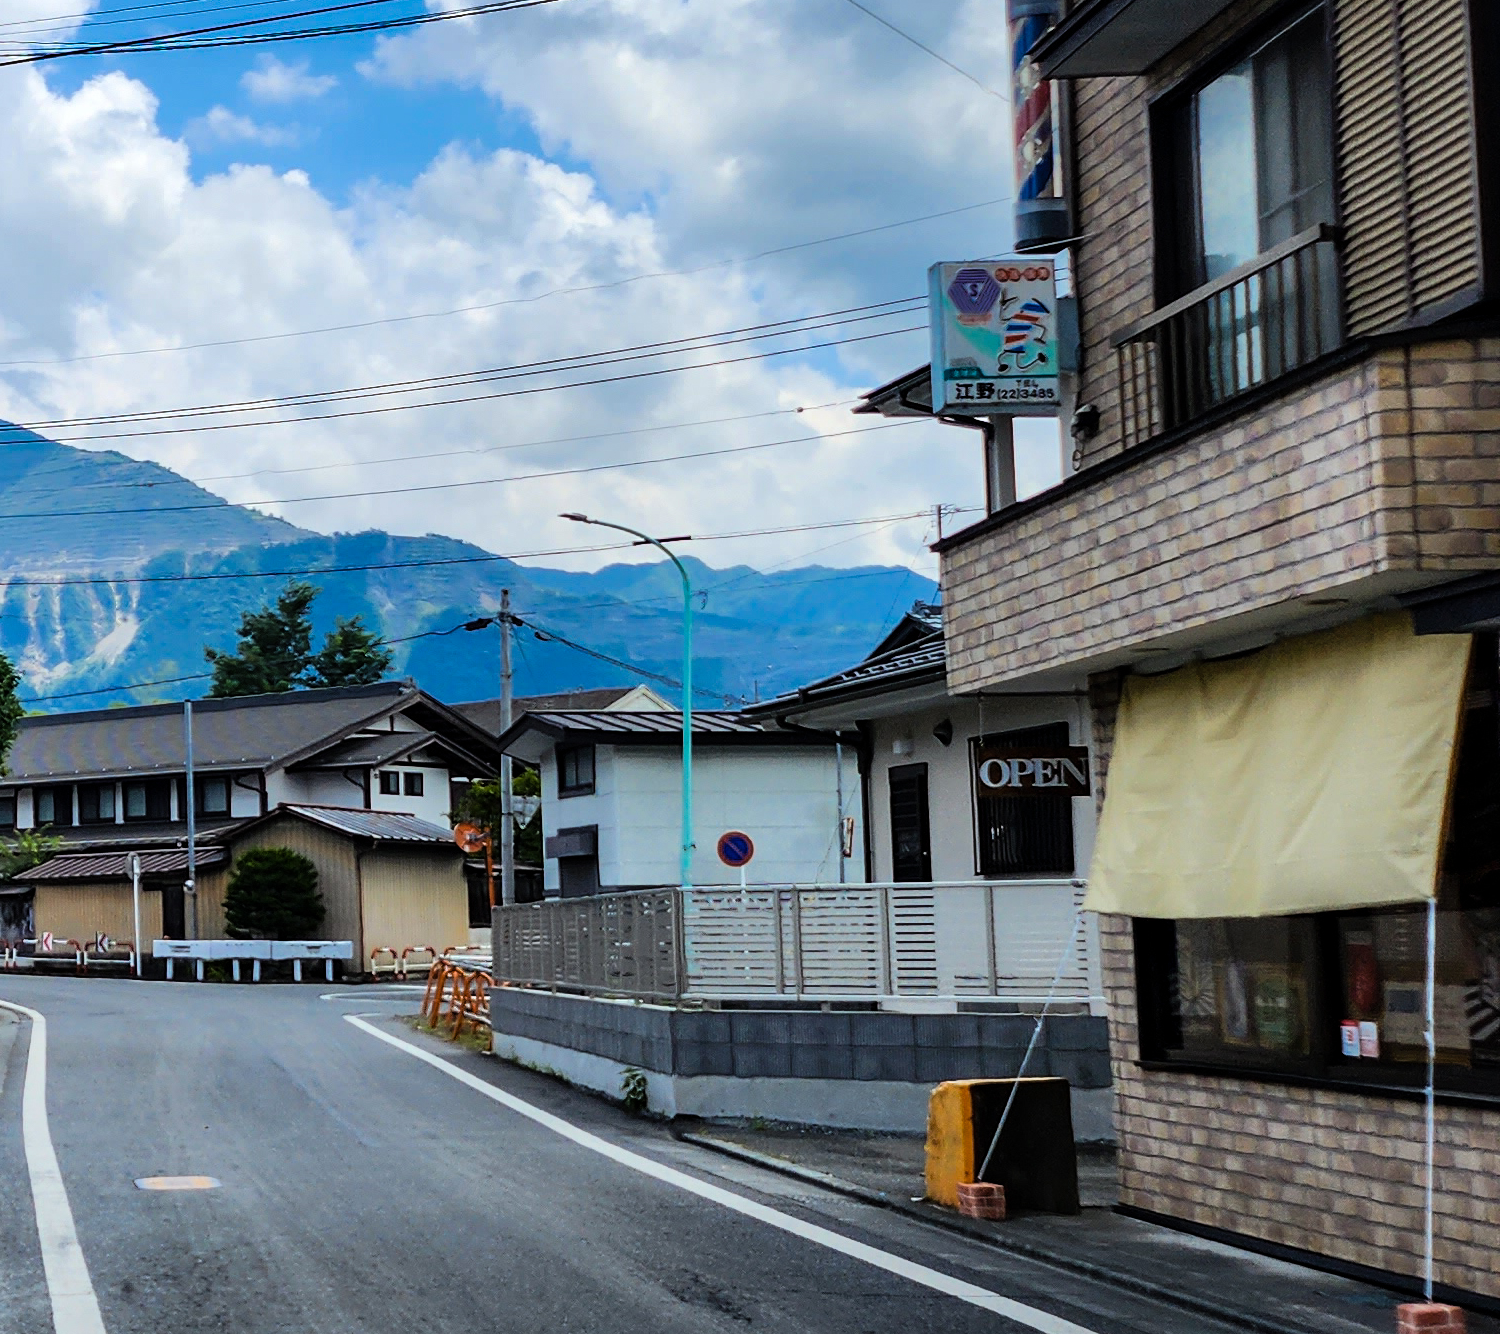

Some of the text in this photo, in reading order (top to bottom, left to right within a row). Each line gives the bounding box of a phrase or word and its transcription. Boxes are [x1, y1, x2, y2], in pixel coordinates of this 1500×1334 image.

[956, 382, 995, 400] 江野
[1016, 379, 1039, 388] TEL
[979, 757, 1088, 788] OPEN
